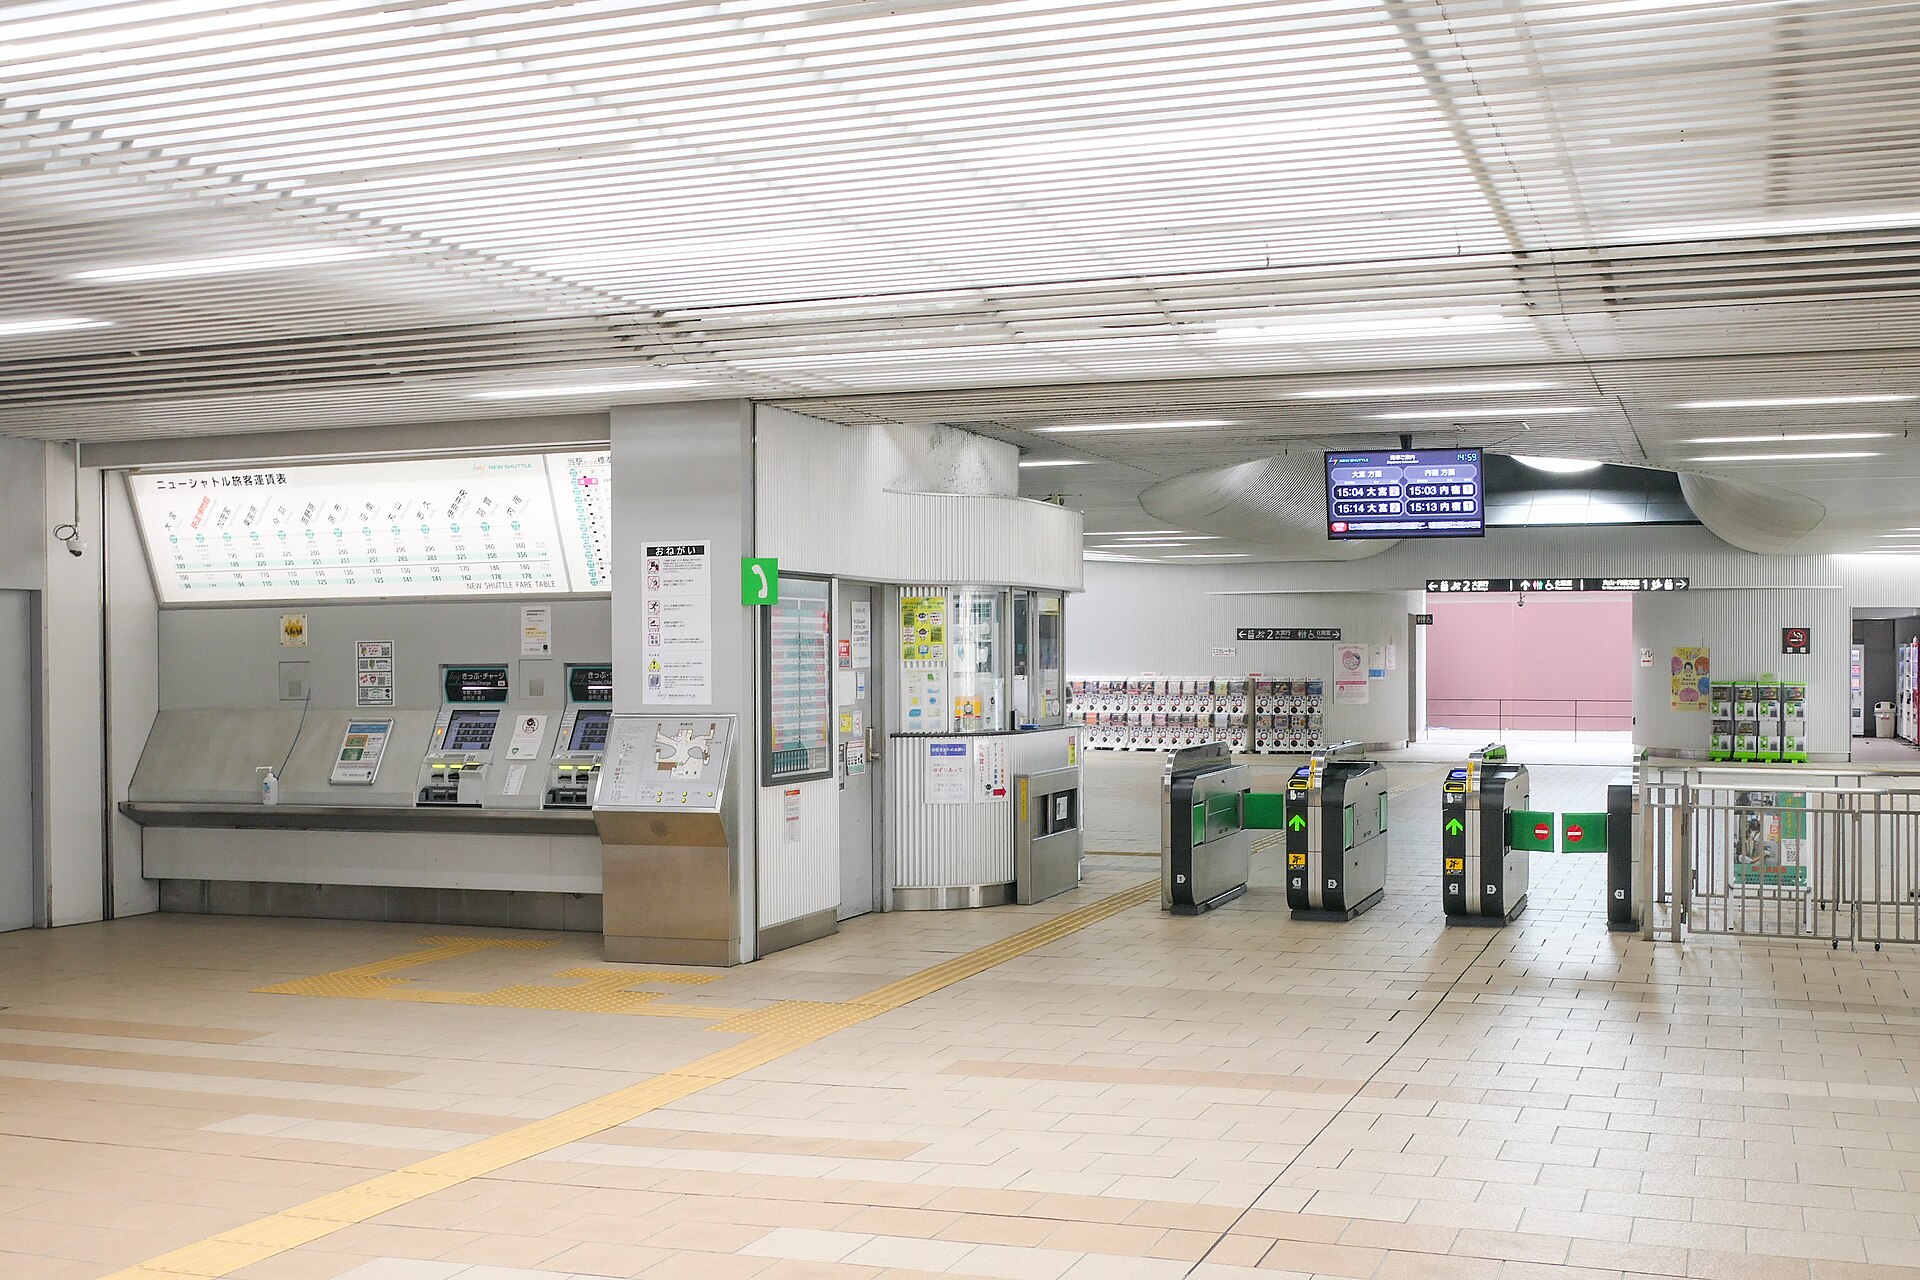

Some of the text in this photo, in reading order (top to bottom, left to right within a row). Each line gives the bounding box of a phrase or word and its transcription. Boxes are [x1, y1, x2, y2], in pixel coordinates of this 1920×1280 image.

[1456, 453, 1477, 462] 14:59
[157, 473, 287, 489] ニューシャトル旅客運賃表
[1336, 487, 1364, 497] 15:04
[1366, 486, 1388, 497] 大宮
[1409, 486, 1437, 496] 15:03
[1439, 485, 1461, 496] 内宿
[1337, 503, 1364, 513] 15:14
[1366, 502, 1388, 513] 大宮
[1409, 502, 1438, 512] 15:13
[1439, 502, 1461, 512] 内宿
[654, 545, 696, 557] おねがい
[466, 582, 482, 590] NEW
[484, 581, 514, 589] SHUTTLE
[535, 580, 556, 588] TABLE
[1462, 581, 1471, 591] 2
[1642, 578, 1648, 590] 1
[1267, 629, 1274, 639] 2
[461, 672, 505, 680] きっぷ・チャージ
